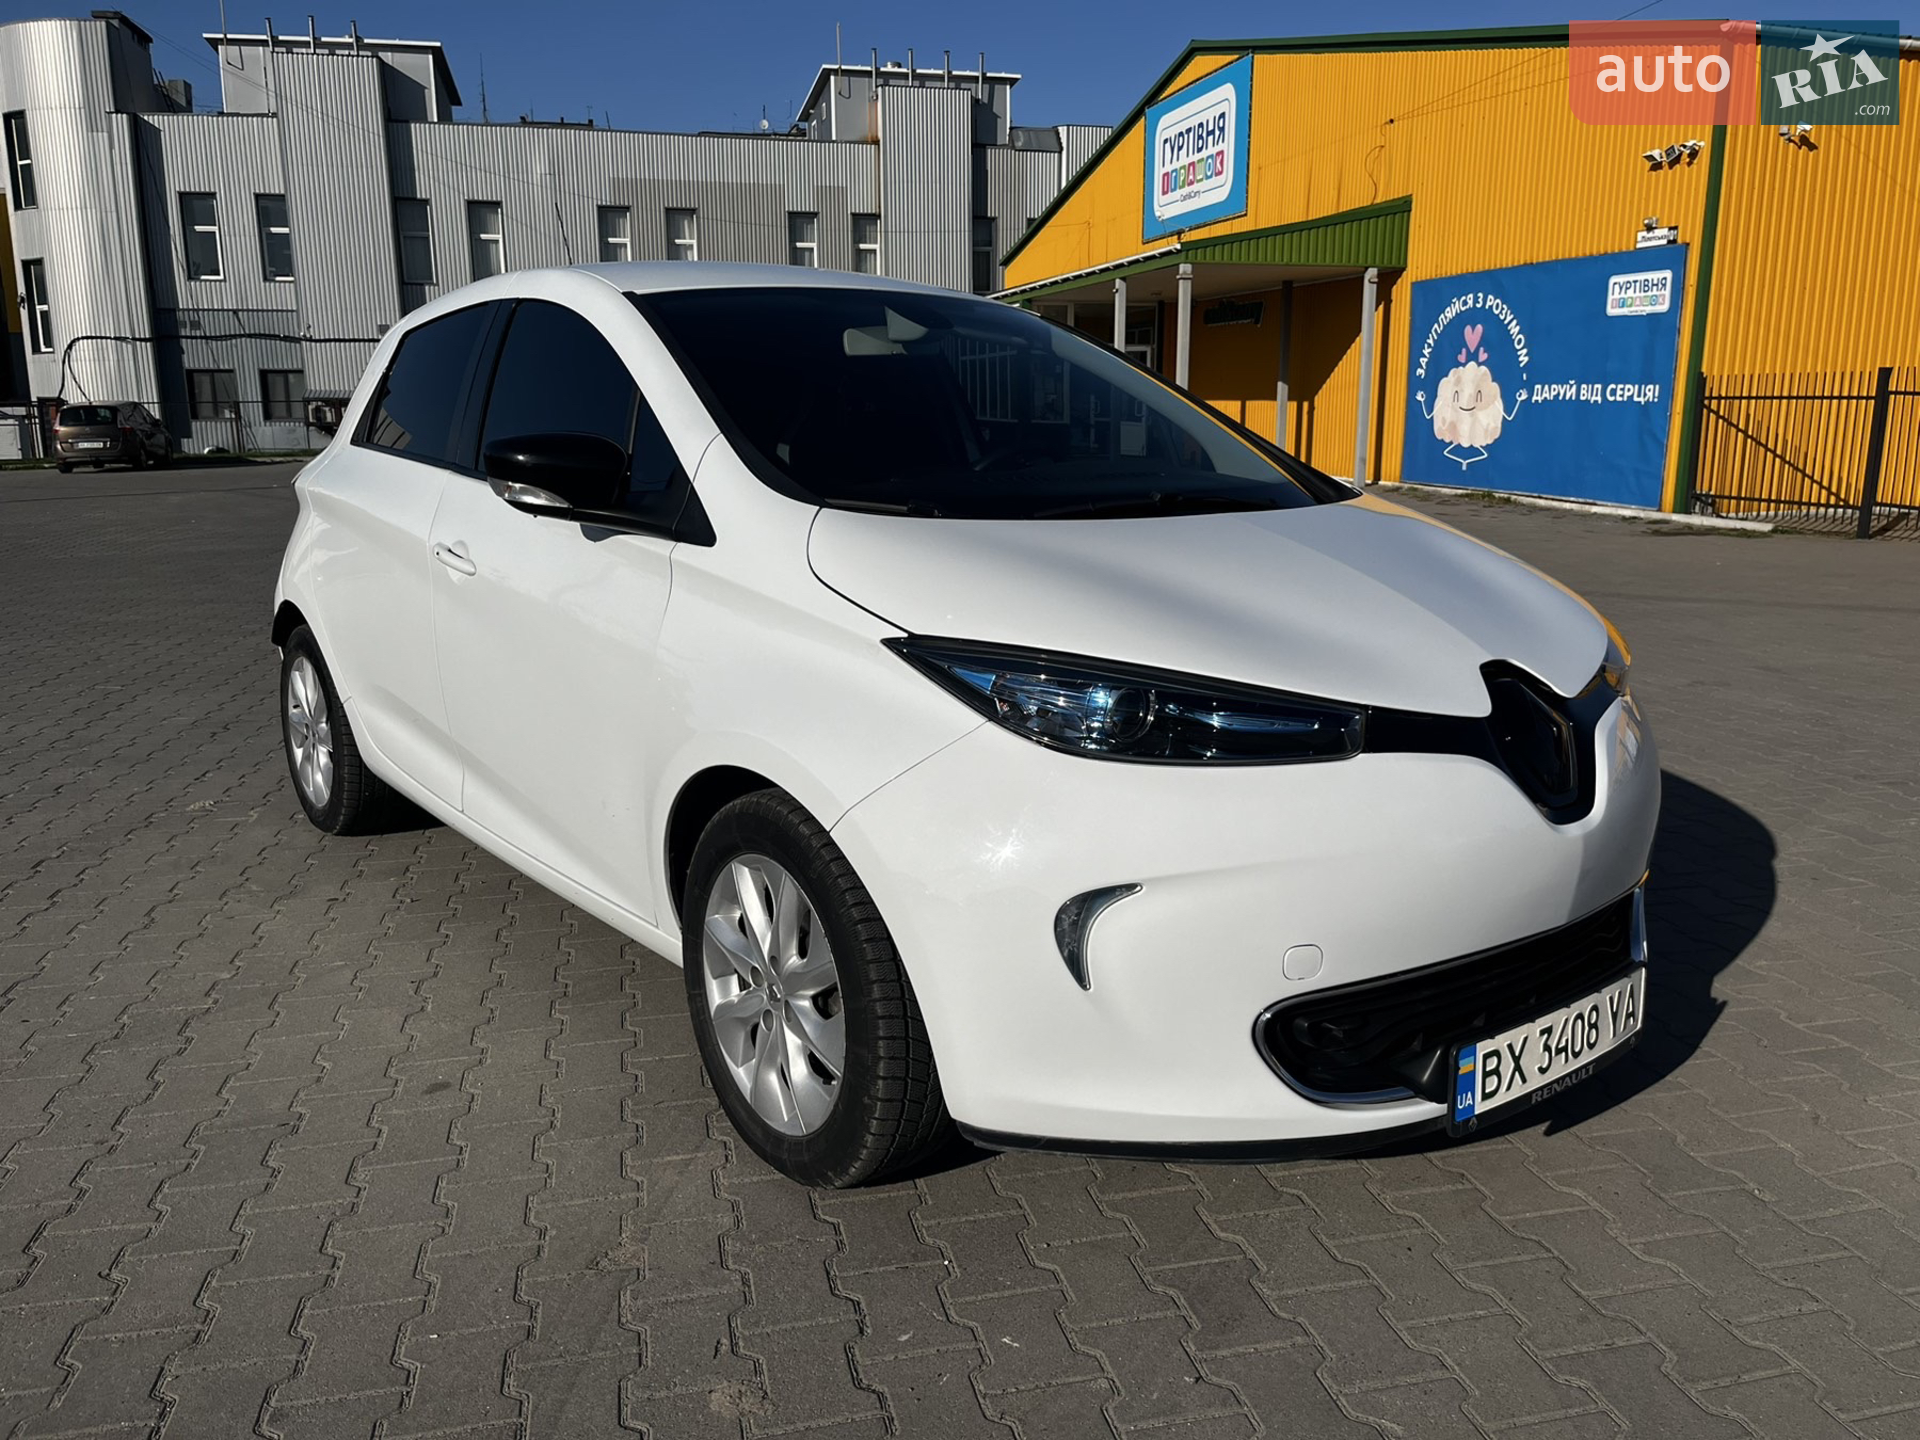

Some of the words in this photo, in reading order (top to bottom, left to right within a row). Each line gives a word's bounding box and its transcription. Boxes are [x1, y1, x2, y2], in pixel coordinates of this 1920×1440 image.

[1162, 111, 1226, 168] ГУРТІВНЯ
[1611, 276, 1668, 296] ГУРТІВНЯ
[1416, 293, 1474, 379] ЗАКУПЛЯЙСЯ
[1485, 294, 1529, 367] РОЗУМОМ
[1531, 379, 1577, 404] ДАРУЙ
[1580, 383, 1602, 404] ВІД
[1606, 383, 1660, 405] СЕРЦЯ!
[1479, 1034, 1529, 1102] BX
[1535, 1003, 1600, 1075] 3408
[1606, 981, 1636, 1040] YA
[1457, 1091, 1474, 1110] UA
[1530, 1062, 1596, 1105] RENAULT
